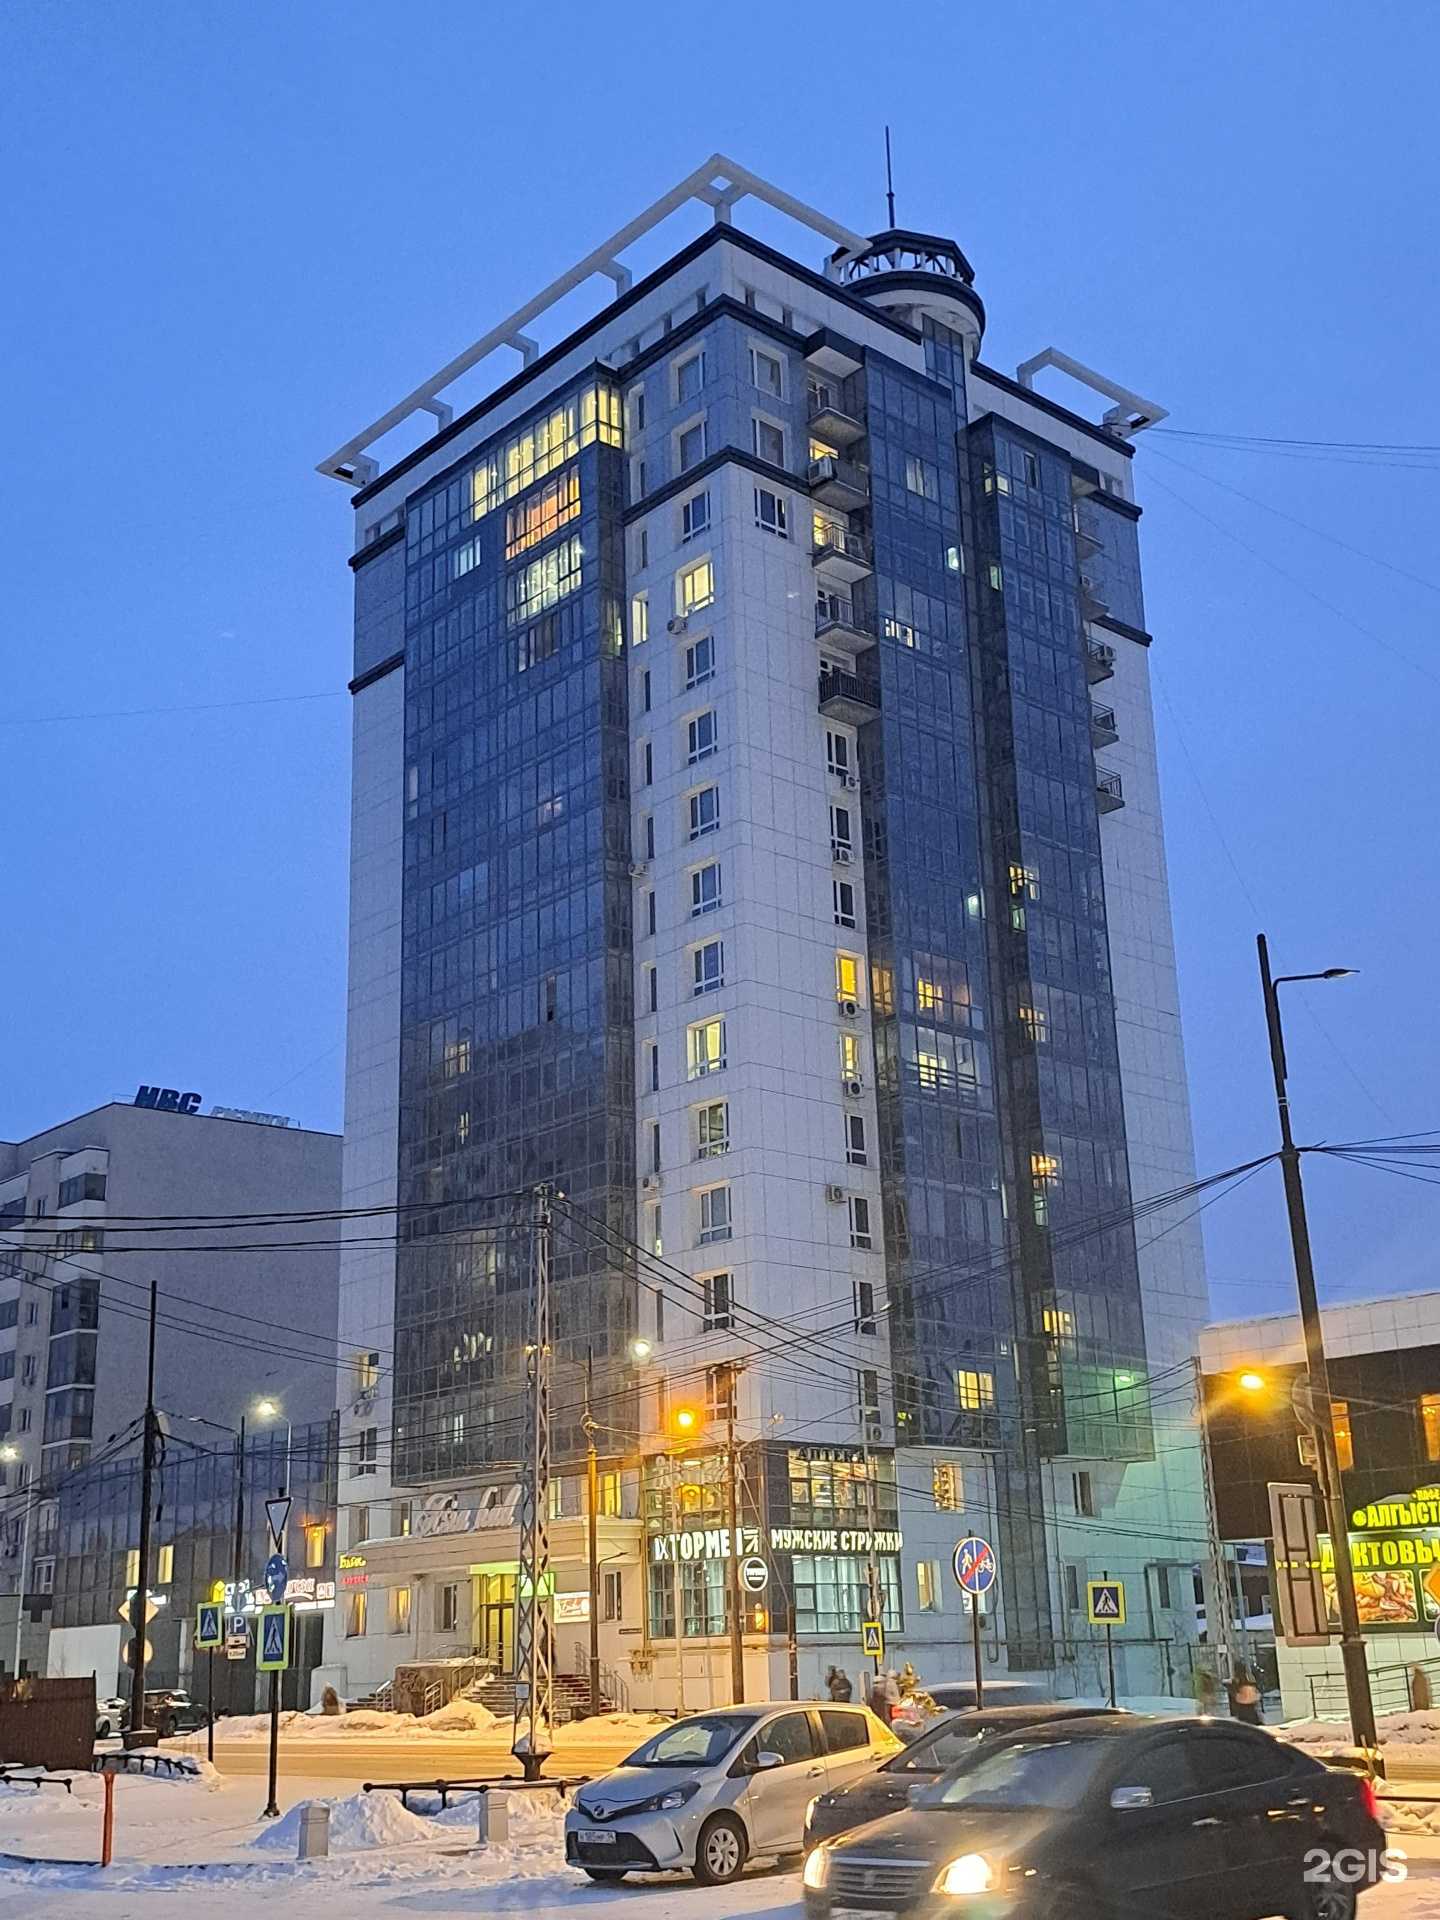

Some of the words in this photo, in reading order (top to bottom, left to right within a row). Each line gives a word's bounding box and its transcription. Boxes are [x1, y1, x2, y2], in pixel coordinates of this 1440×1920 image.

[798, 1447, 865, 1463] АПТЕКА
[1367, 1501, 1440, 1527] АЛГЫСТ
[771, 1529, 838, 1550] МУЖСКИЕ
[841, 1531, 903, 1551] СТРИЖКИ
